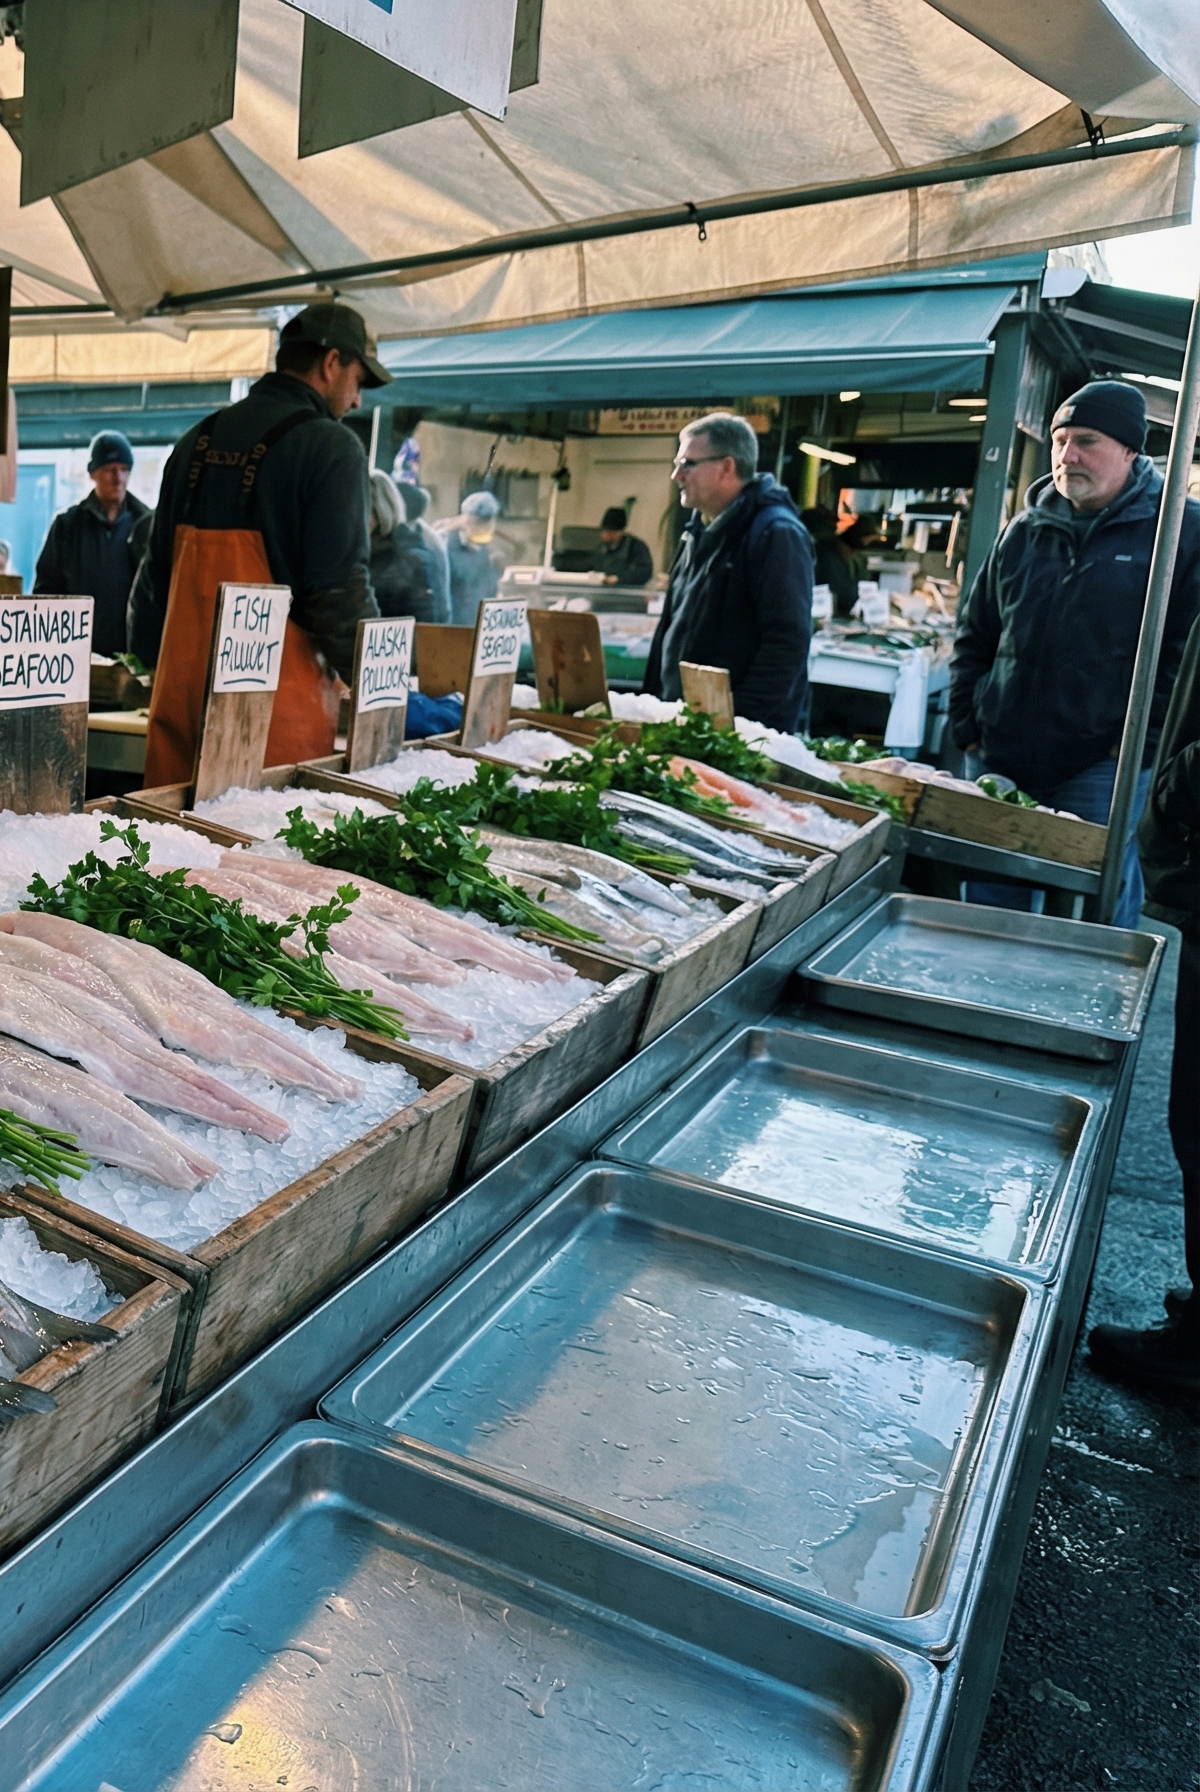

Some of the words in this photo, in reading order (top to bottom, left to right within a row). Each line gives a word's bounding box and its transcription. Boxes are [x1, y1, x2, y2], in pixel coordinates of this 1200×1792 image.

[233, 594, 272, 636] FISH
[364, 626, 408, 661] ALASKA
[362, 661, 409, 697] POLLOCK
